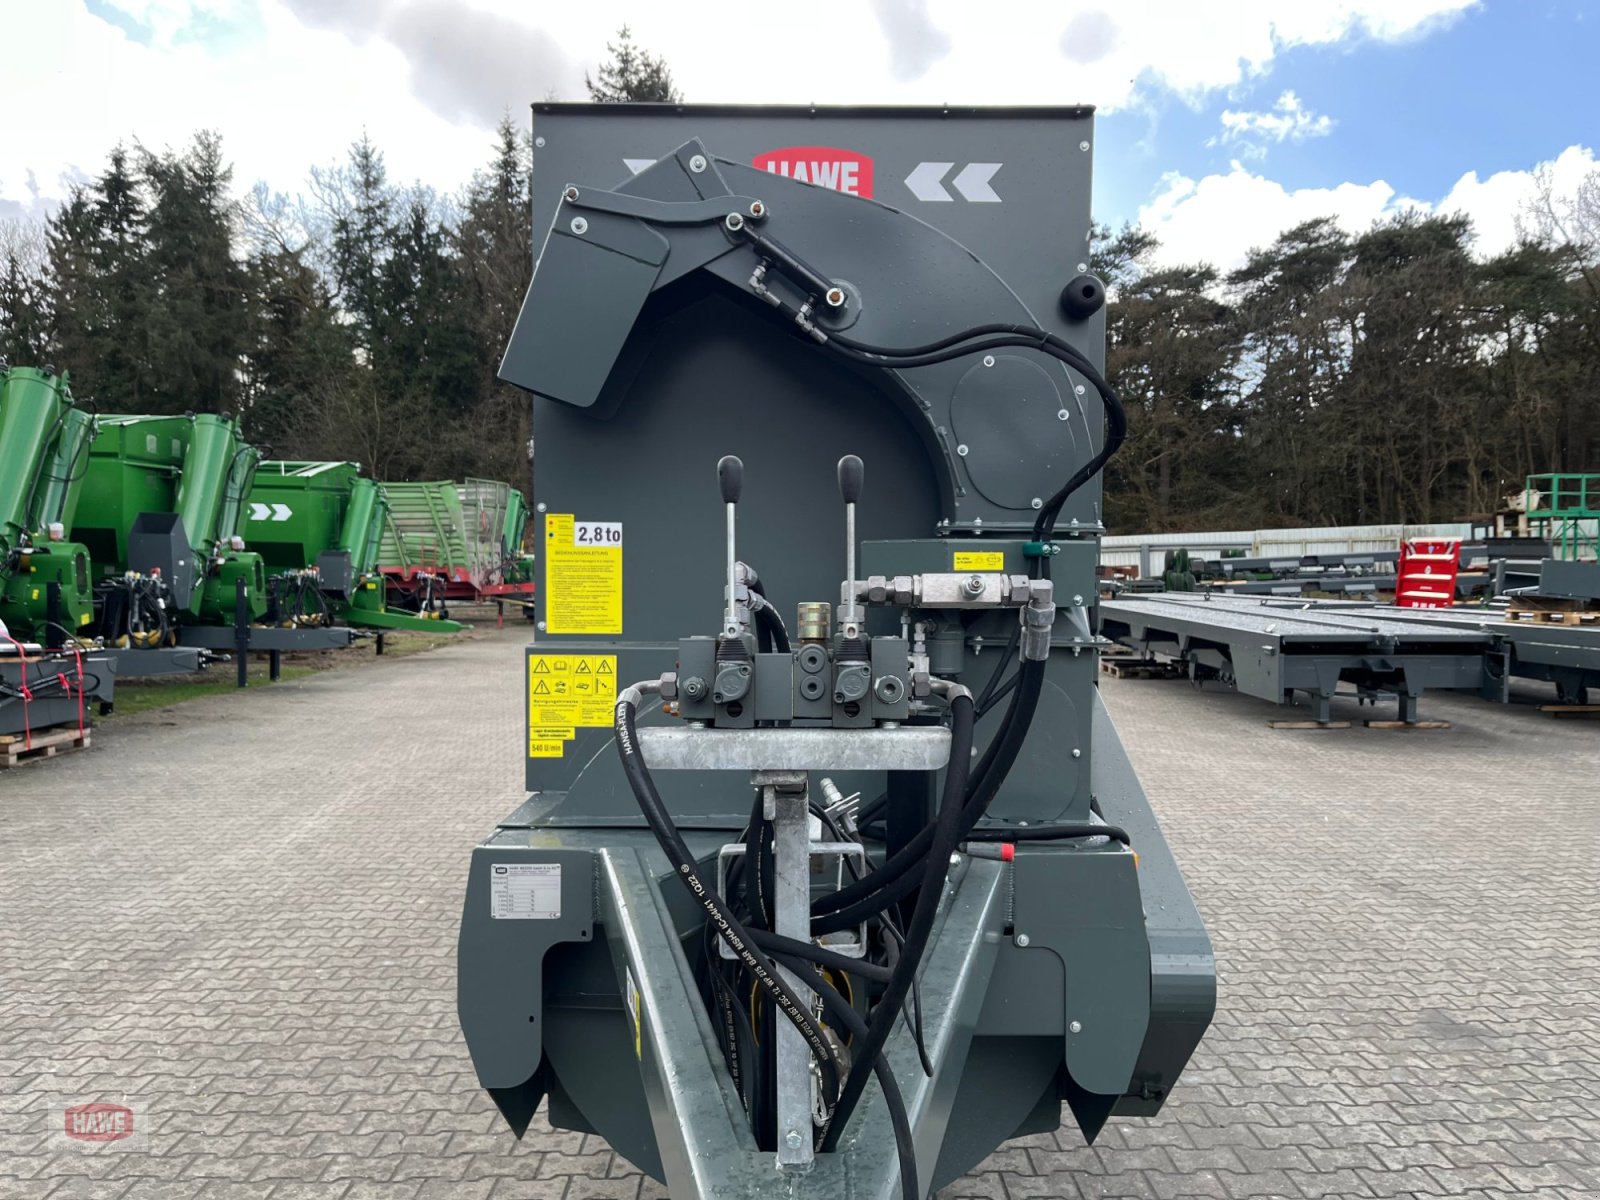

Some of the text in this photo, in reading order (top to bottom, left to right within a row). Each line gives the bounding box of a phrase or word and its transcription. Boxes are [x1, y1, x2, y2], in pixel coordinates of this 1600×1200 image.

[687, 874, 705, 897] 1Q22
[703, 899, 729, 930] IC-84/41
[725, 928, 745, 950] MSHA
[742, 950, 757, 966] BAR
[754, 966, 767, 978] 275
[763, 977, 774, 988] WP
[772, 986, 781, 995] 12
[779, 995, 791, 1006] 2SC
